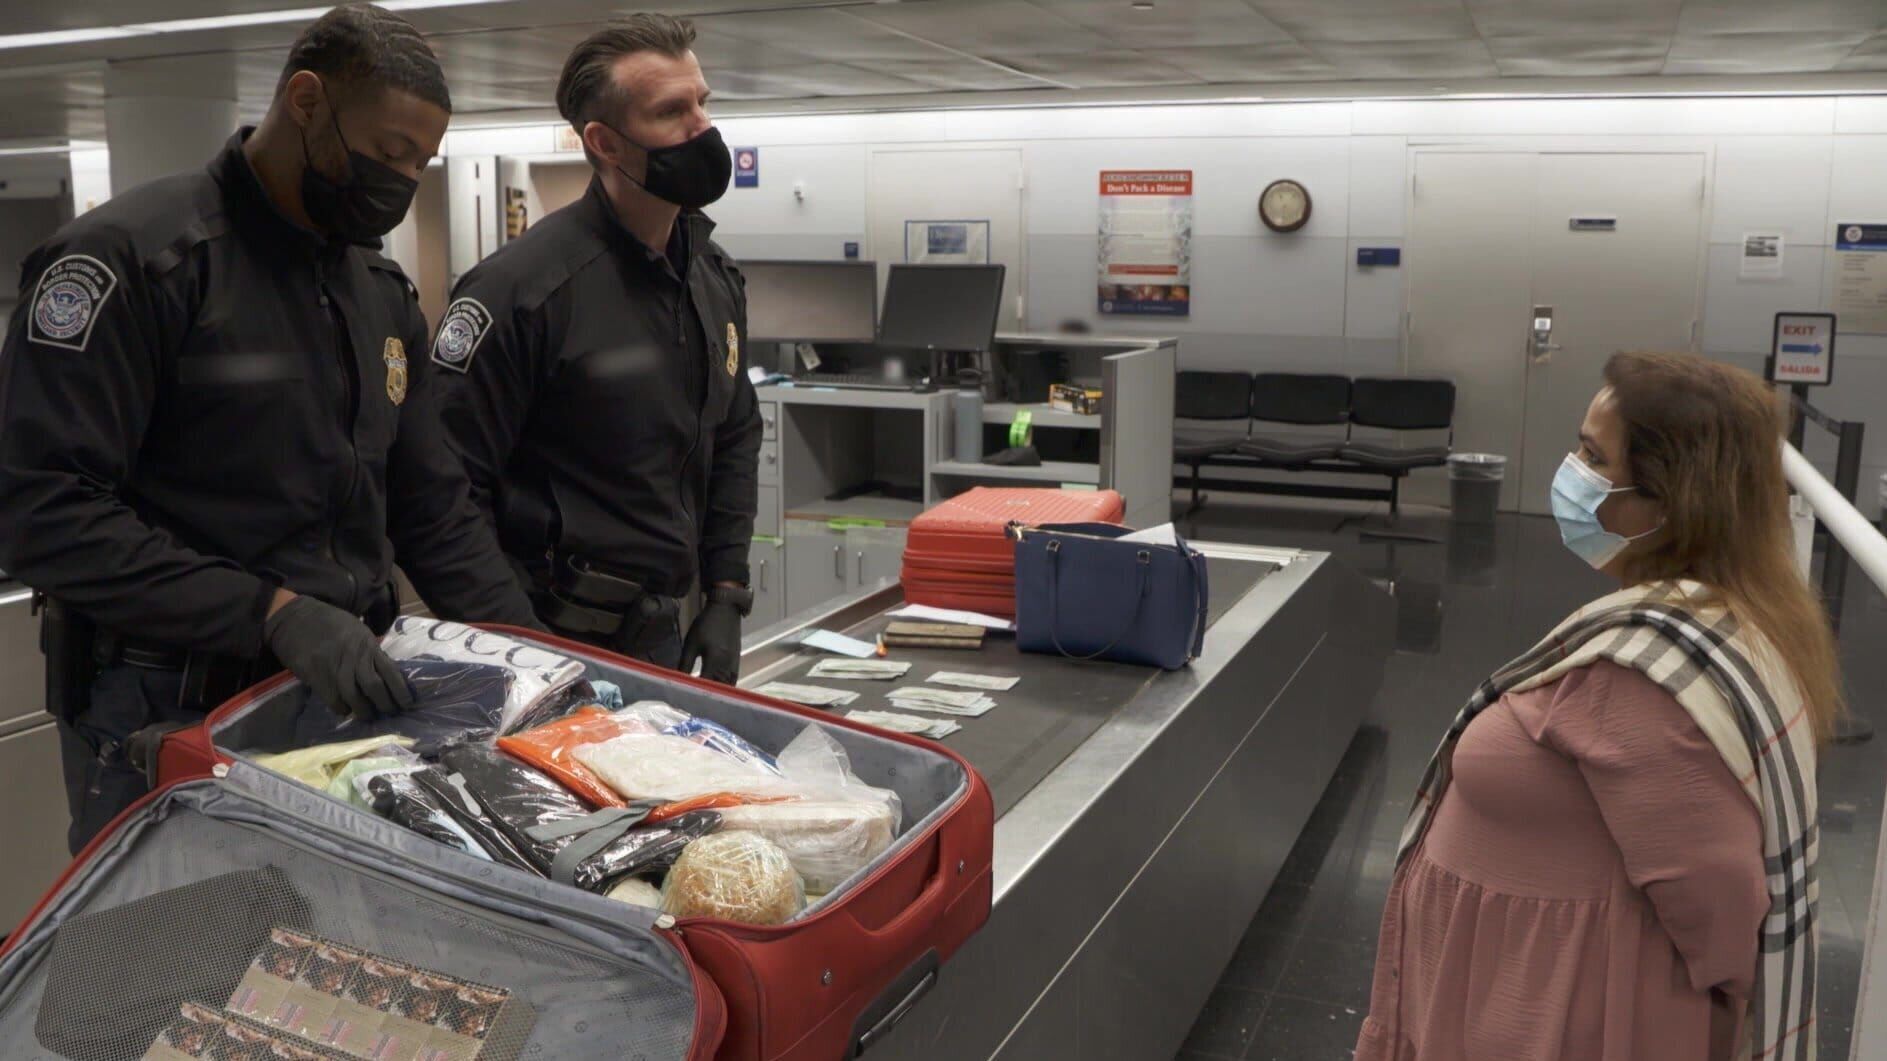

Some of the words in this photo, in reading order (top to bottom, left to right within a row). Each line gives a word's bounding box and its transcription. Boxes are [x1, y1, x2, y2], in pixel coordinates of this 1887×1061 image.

[1107, 183, 1129, 193] Don't
[1131, 184, 1149, 193] Pack
[1156, 184, 1185, 193] Disease
[65, 262, 97, 276] CUSTOMS
[41, 272, 69, 290] BORDER
[68, 271, 101, 300] PROTECTION
[1783, 325, 1816, 336] EXIT
[1780, 365, 1821, 376] SALIDA
